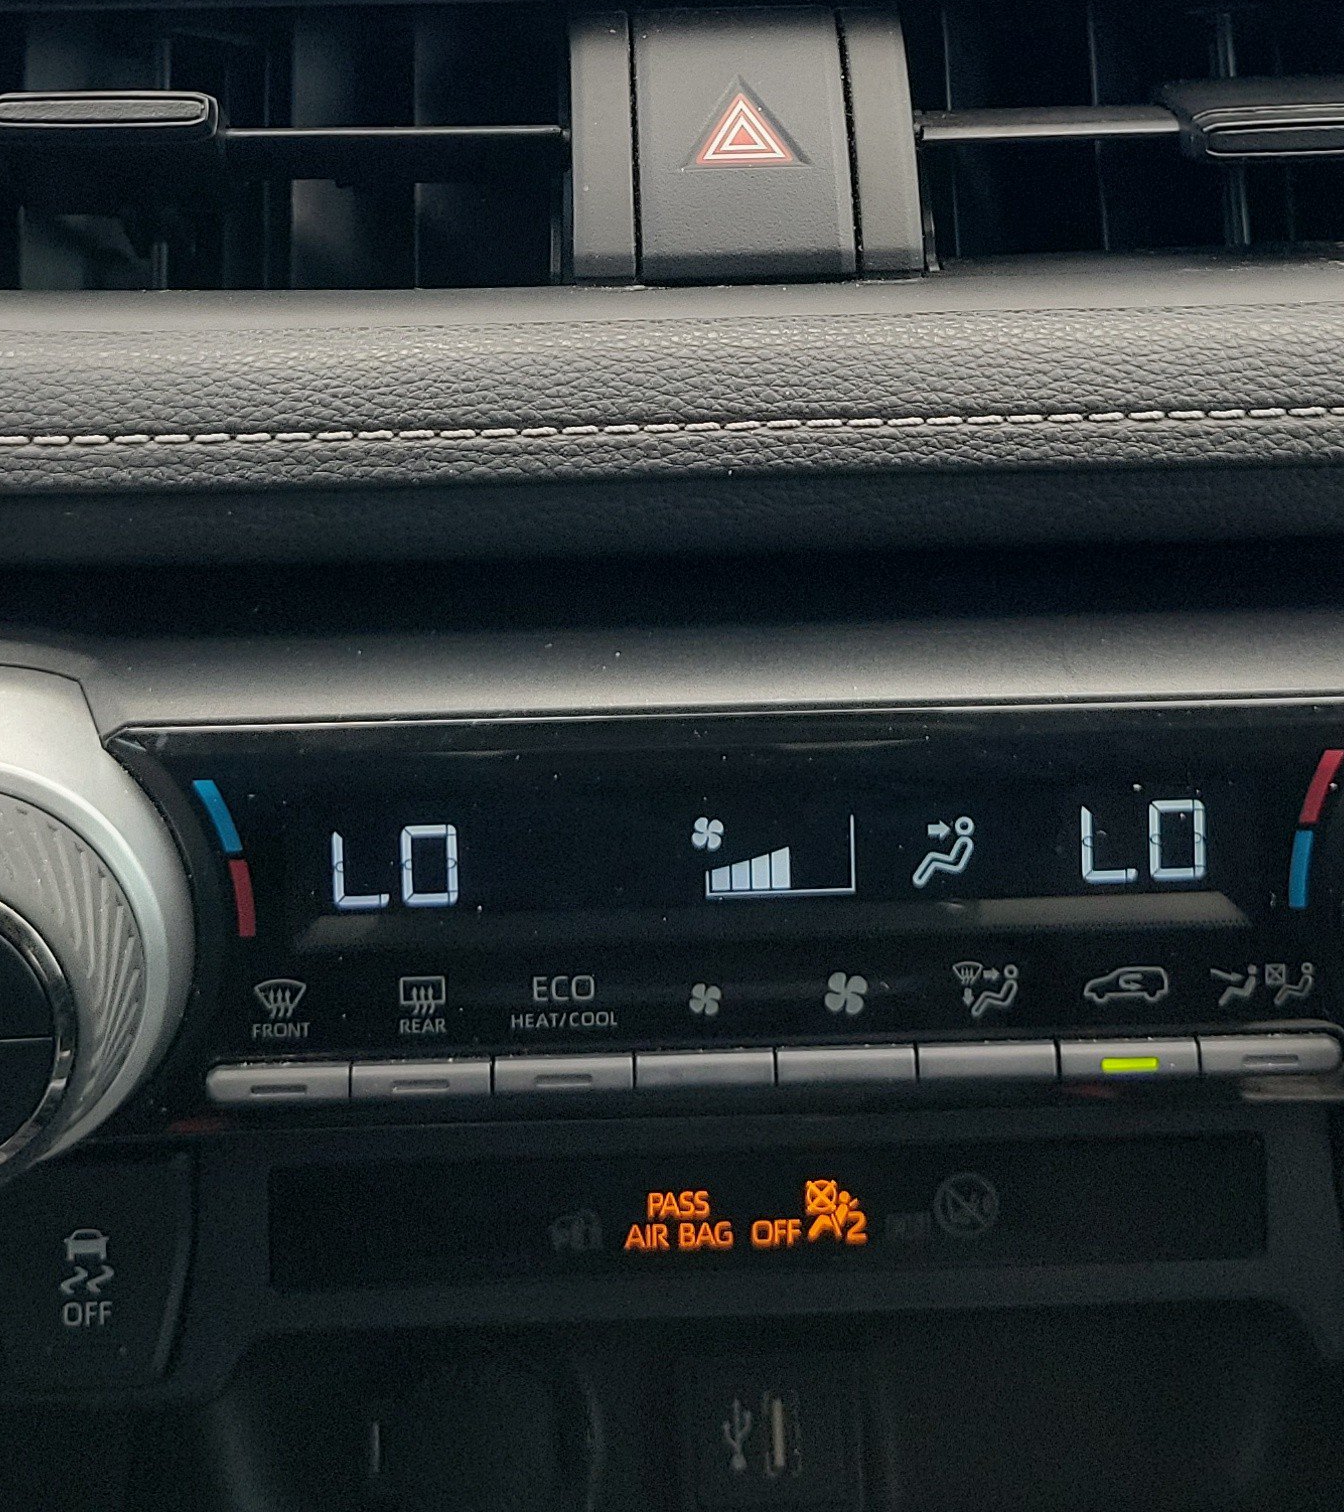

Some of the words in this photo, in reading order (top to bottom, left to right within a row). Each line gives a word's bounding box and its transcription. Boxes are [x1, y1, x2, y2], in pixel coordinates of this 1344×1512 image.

[1080, 799, 1206, 883] LO
[331, 824, 459, 908] LO
[532, 974, 596, 1003] ECO
[251, 1021, 310, 1039] FRONT
[399, 1018, 447, 1035] REAR
[510, 1010, 618, 1030] HEAT/COOL
[648, 1190, 710, 1218] PASS
[624, 1223, 670, 1249] AIR
[678, 1221, 734, 1249] BAG
[751, 1218, 801, 1246] OFF
[62, 1300, 112, 1327] OFF
